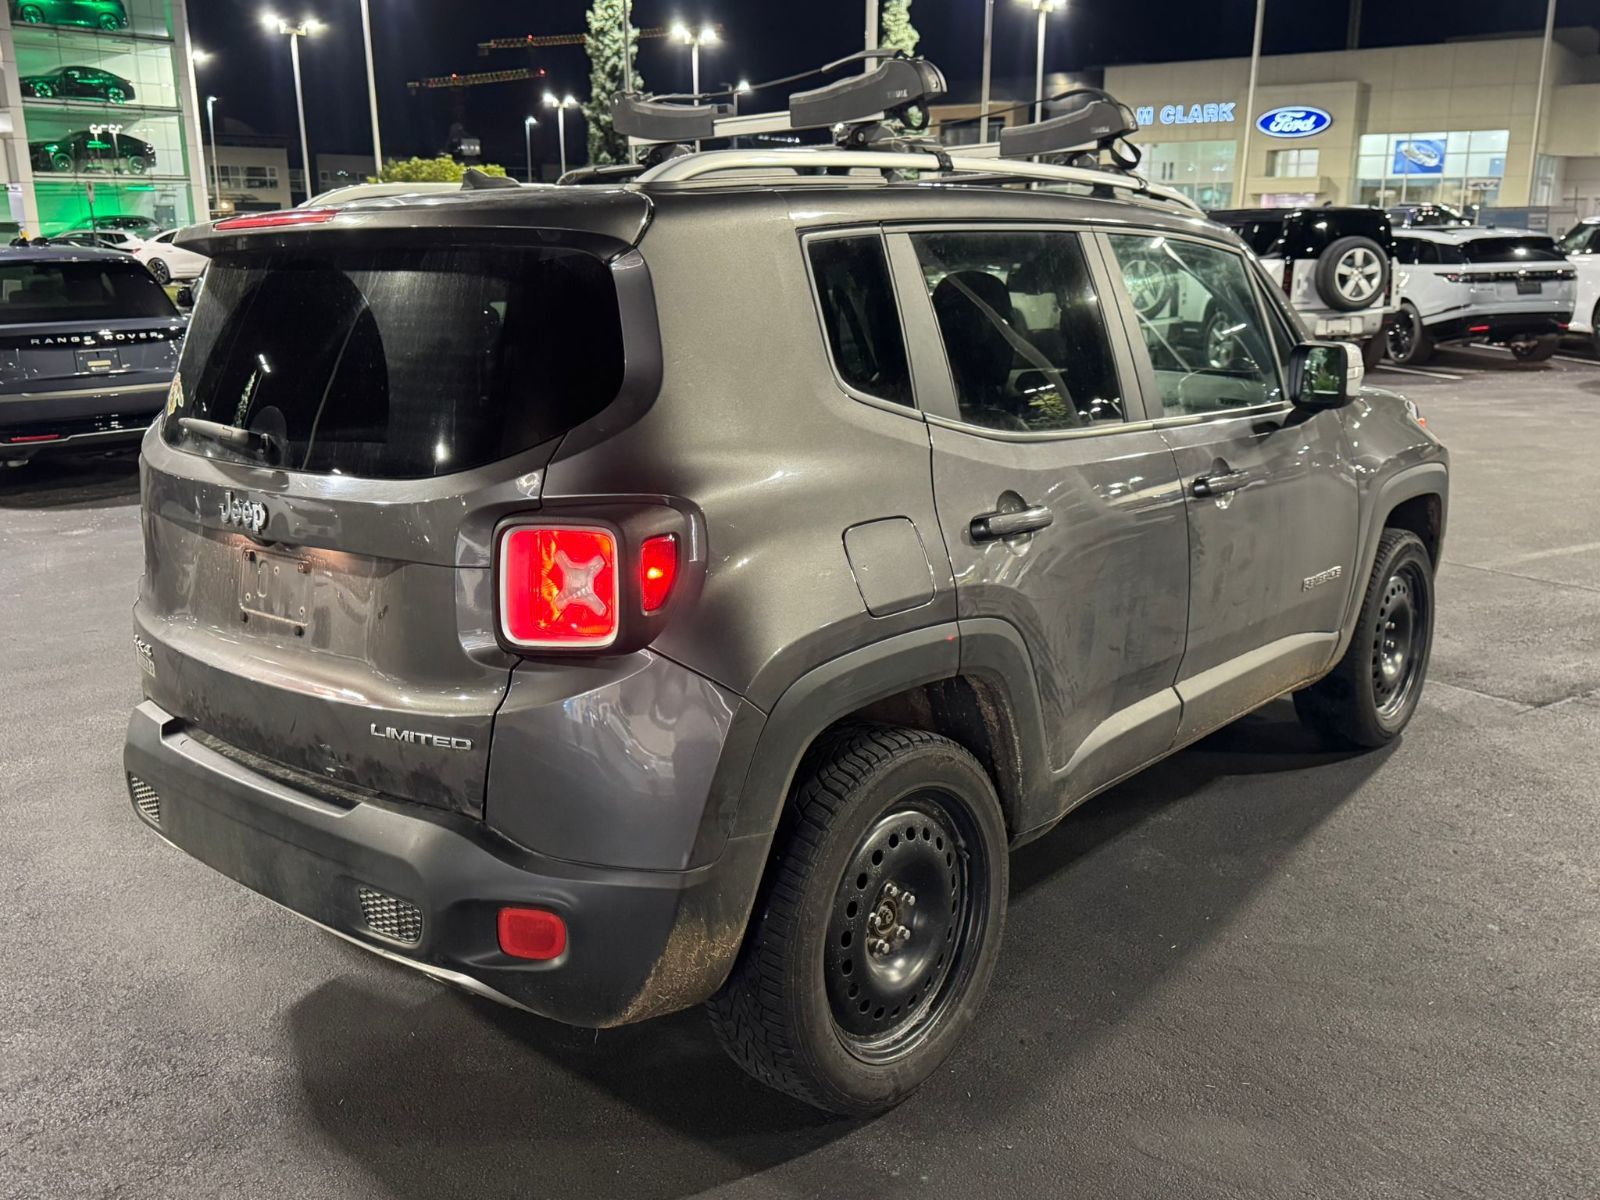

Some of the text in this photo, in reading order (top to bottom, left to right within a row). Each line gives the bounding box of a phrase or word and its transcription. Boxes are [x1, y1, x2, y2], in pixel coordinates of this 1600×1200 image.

[1160, 102, 1236, 125] CLARK
[1269, 111, 1317, 132] Ford
[30, 331, 158, 345] RANGE ROVER
[218, 490, 267, 533] Jeep
[370, 722, 472, 751] LIMITED
